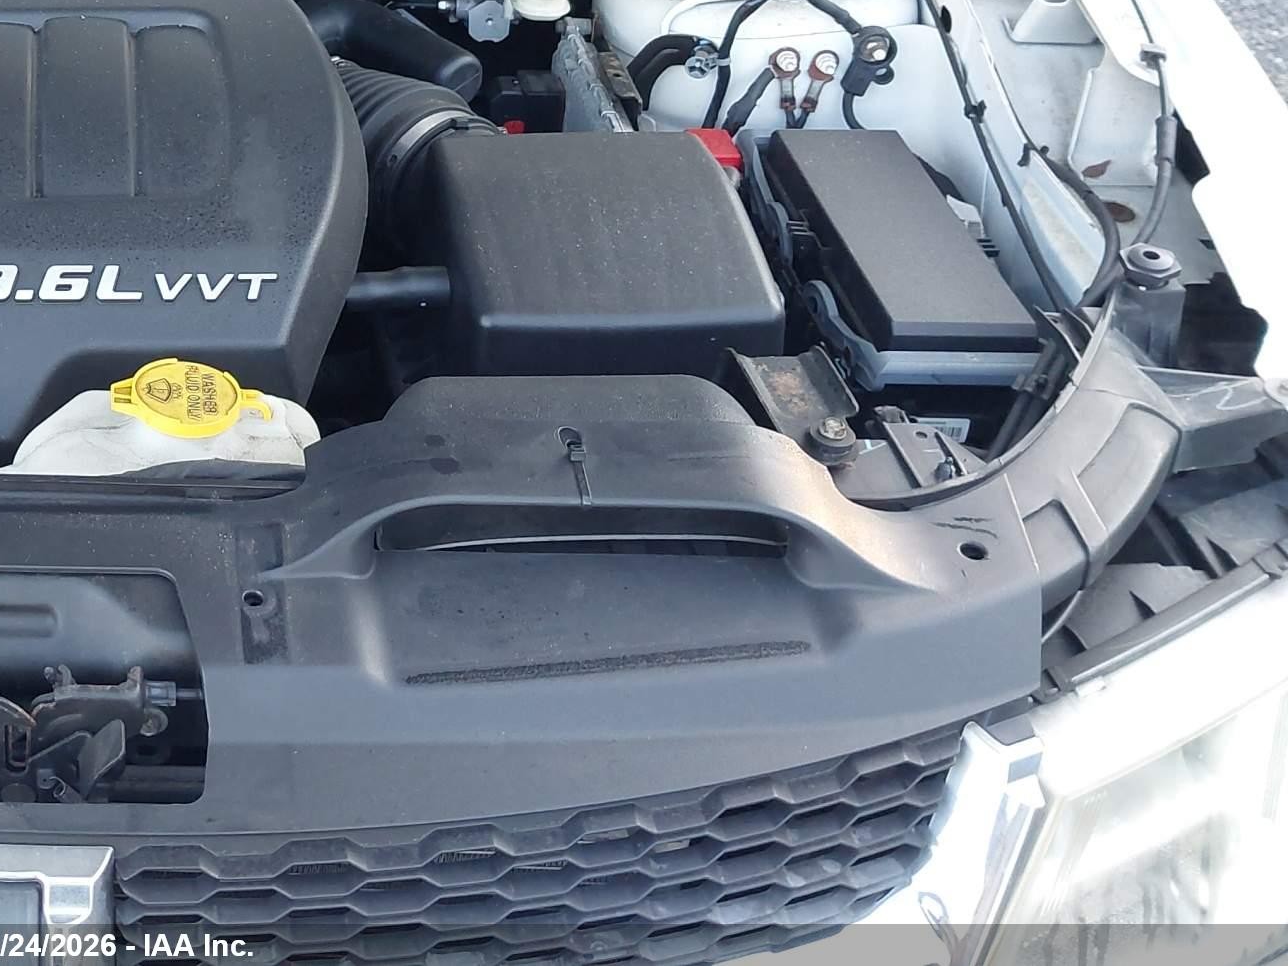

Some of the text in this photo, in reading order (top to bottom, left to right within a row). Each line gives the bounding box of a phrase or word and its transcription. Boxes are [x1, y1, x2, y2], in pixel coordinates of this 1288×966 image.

[154, 272, 278, 301] VVT
[185, 364, 201, 422] FLUID ONLY
[201, 373, 218, 416] WASHER
